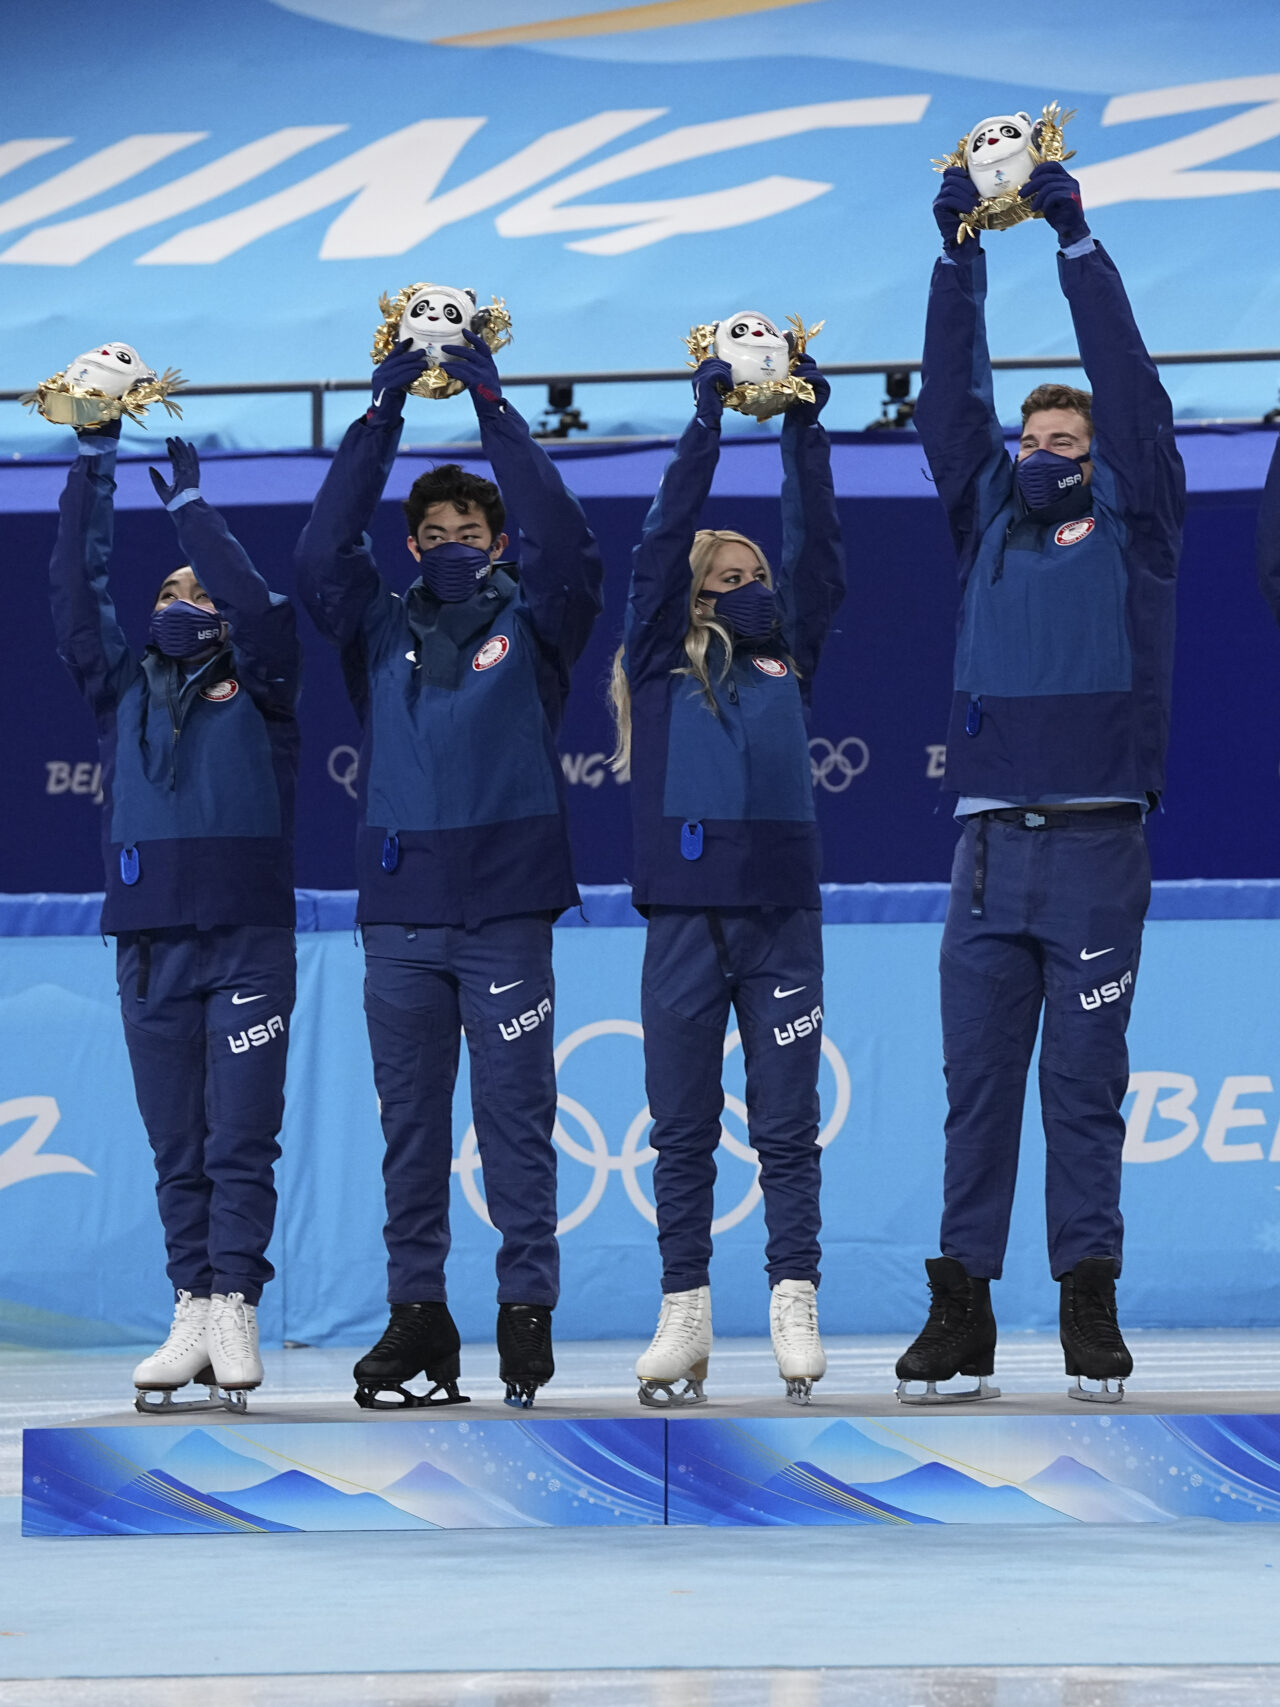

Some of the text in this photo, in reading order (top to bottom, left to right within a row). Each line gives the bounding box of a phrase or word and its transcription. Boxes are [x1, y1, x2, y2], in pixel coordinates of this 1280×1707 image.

[1057, 473, 1082, 489] USA
[198, 628, 219, 640] USA
[1079, 970, 1133, 1011] USA
[227, 1015, 285, 1054] USA
[498, 997, 552, 1042] USA
[773, 1005, 824, 1047] USA
